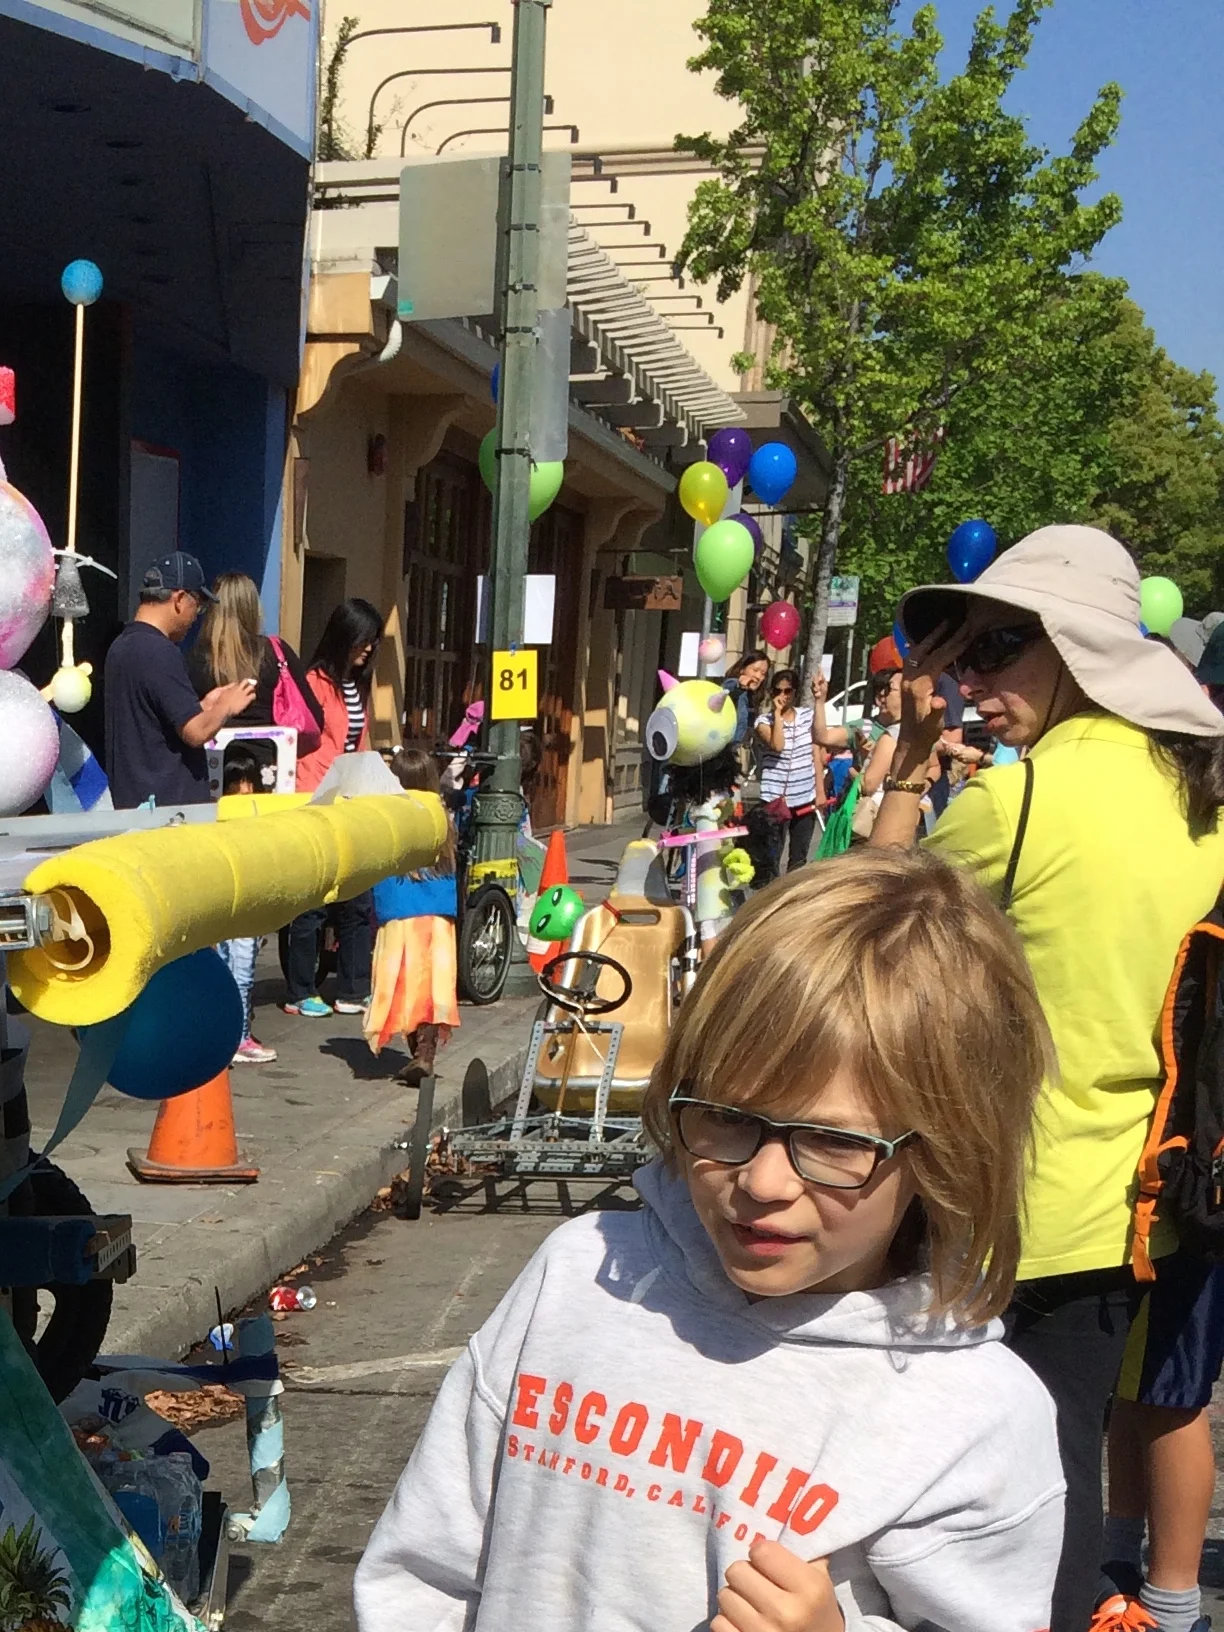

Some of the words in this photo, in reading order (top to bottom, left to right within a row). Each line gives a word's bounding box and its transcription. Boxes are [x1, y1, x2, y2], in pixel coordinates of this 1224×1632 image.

[499, 668, 528, 691] 81
[508, 1434, 636, 1498] STANFORD,
[647, 1484, 766, 1548] CALIFOR
